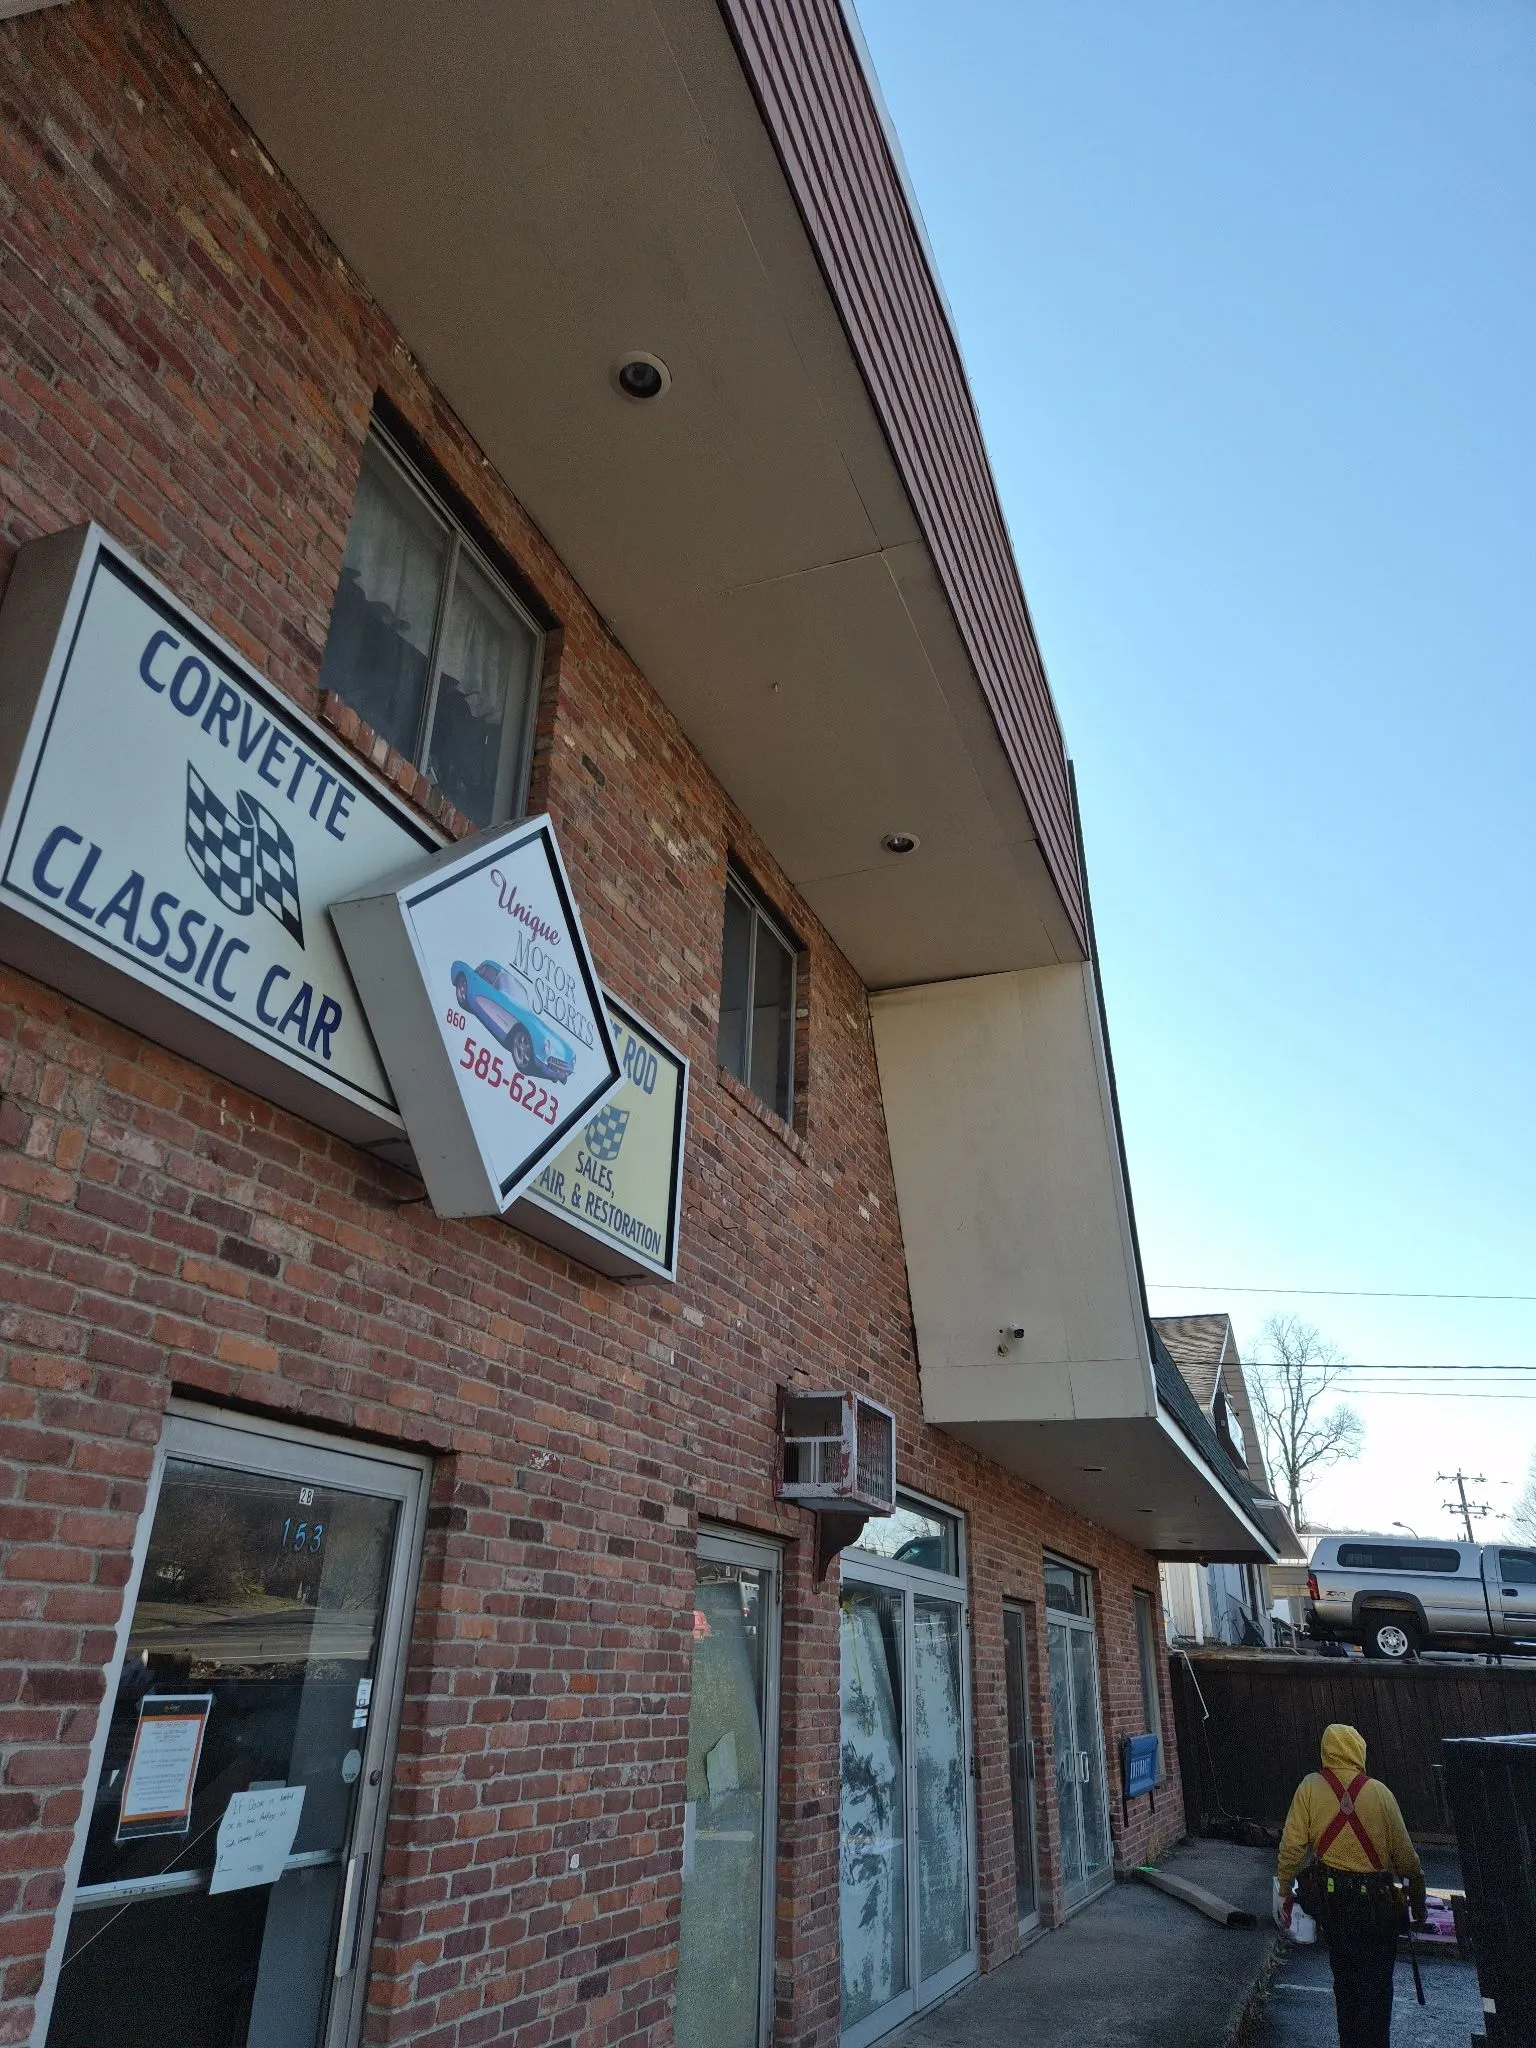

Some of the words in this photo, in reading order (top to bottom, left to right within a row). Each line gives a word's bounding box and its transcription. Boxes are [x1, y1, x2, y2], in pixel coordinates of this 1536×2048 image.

[139, 629, 356, 841] CORVETTE
[32, 825, 250, 1002] CLASSIC
[256, 964, 342, 1060] CAR
[490, 869, 561, 945] Unique
[513, 930, 576, 1004] MOTOR
[446, 1008, 466, 1030] 860
[532, 977, 594, 1046] SPORTS
[460, 1037, 559, 1125] 585-6223
[623, 1034, 658, 1094] ROD
[534, 1164, 566, 1204] AIR,
[571, 1182, 581, 1208] &
[585, 1190, 661, 1255] RESTORATION
[575, 1150, 615, 1198] SALES,
[300, 1488, 313, 1503] 28
[283, 1518, 323, 1552] 153
